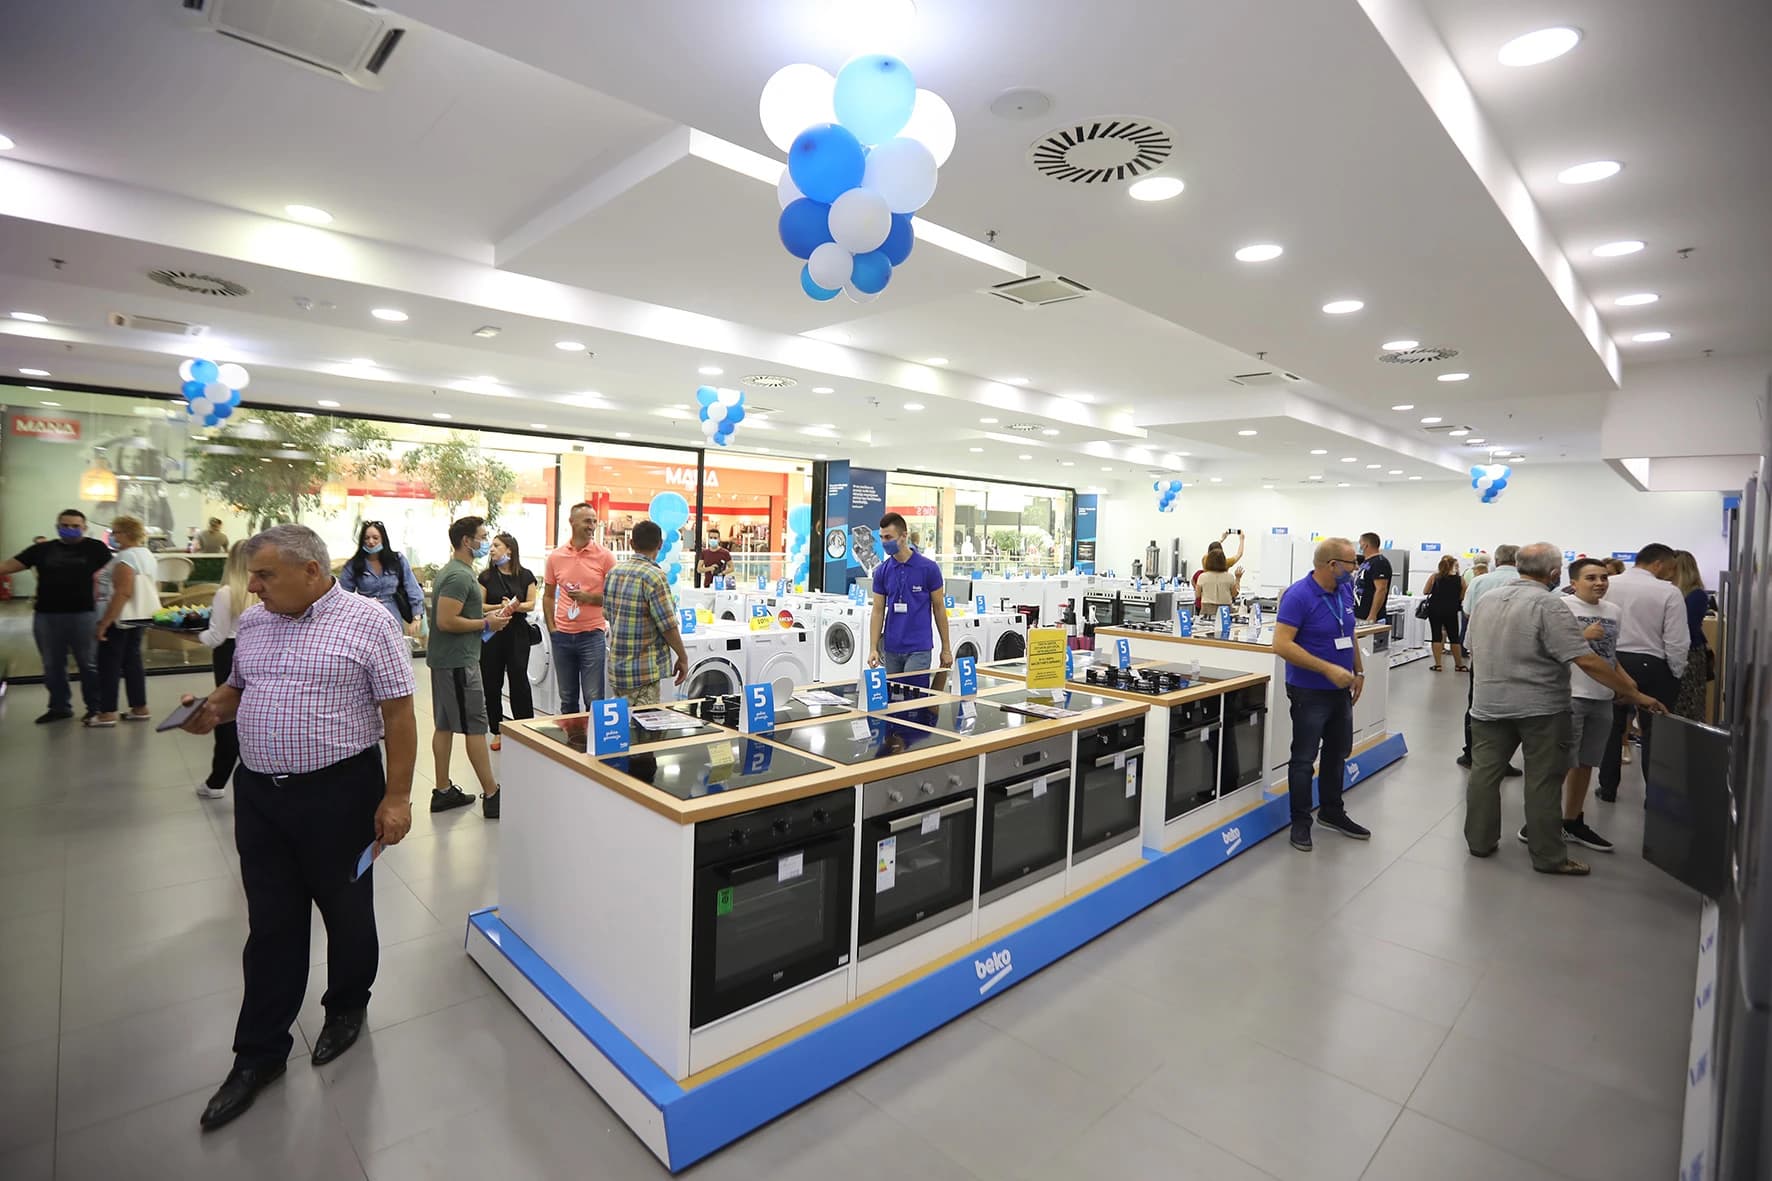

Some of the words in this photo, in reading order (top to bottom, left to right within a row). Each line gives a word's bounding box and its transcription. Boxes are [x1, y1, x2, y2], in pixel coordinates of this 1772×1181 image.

[15, 419, 76, 435] MANA
[946, 597, 953, 607] 5
[977, 596, 984, 605] 5
[684, 609, 694, 621] 5
[756, 606, 765, 617] 5
[1181, 611, 1188, 623] 5
[1222, 607, 1228, 618] 5
[1120, 640, 1127, 654] 5
[963, 659, 972, 676] 5
[870, 671, 882, 689] 5
[753, 687, 767, 708] 5
[603, 702, 620, 727] 5
[1221, 827, 1241, 845] beko
[974, 949, 1012, 980] beko
